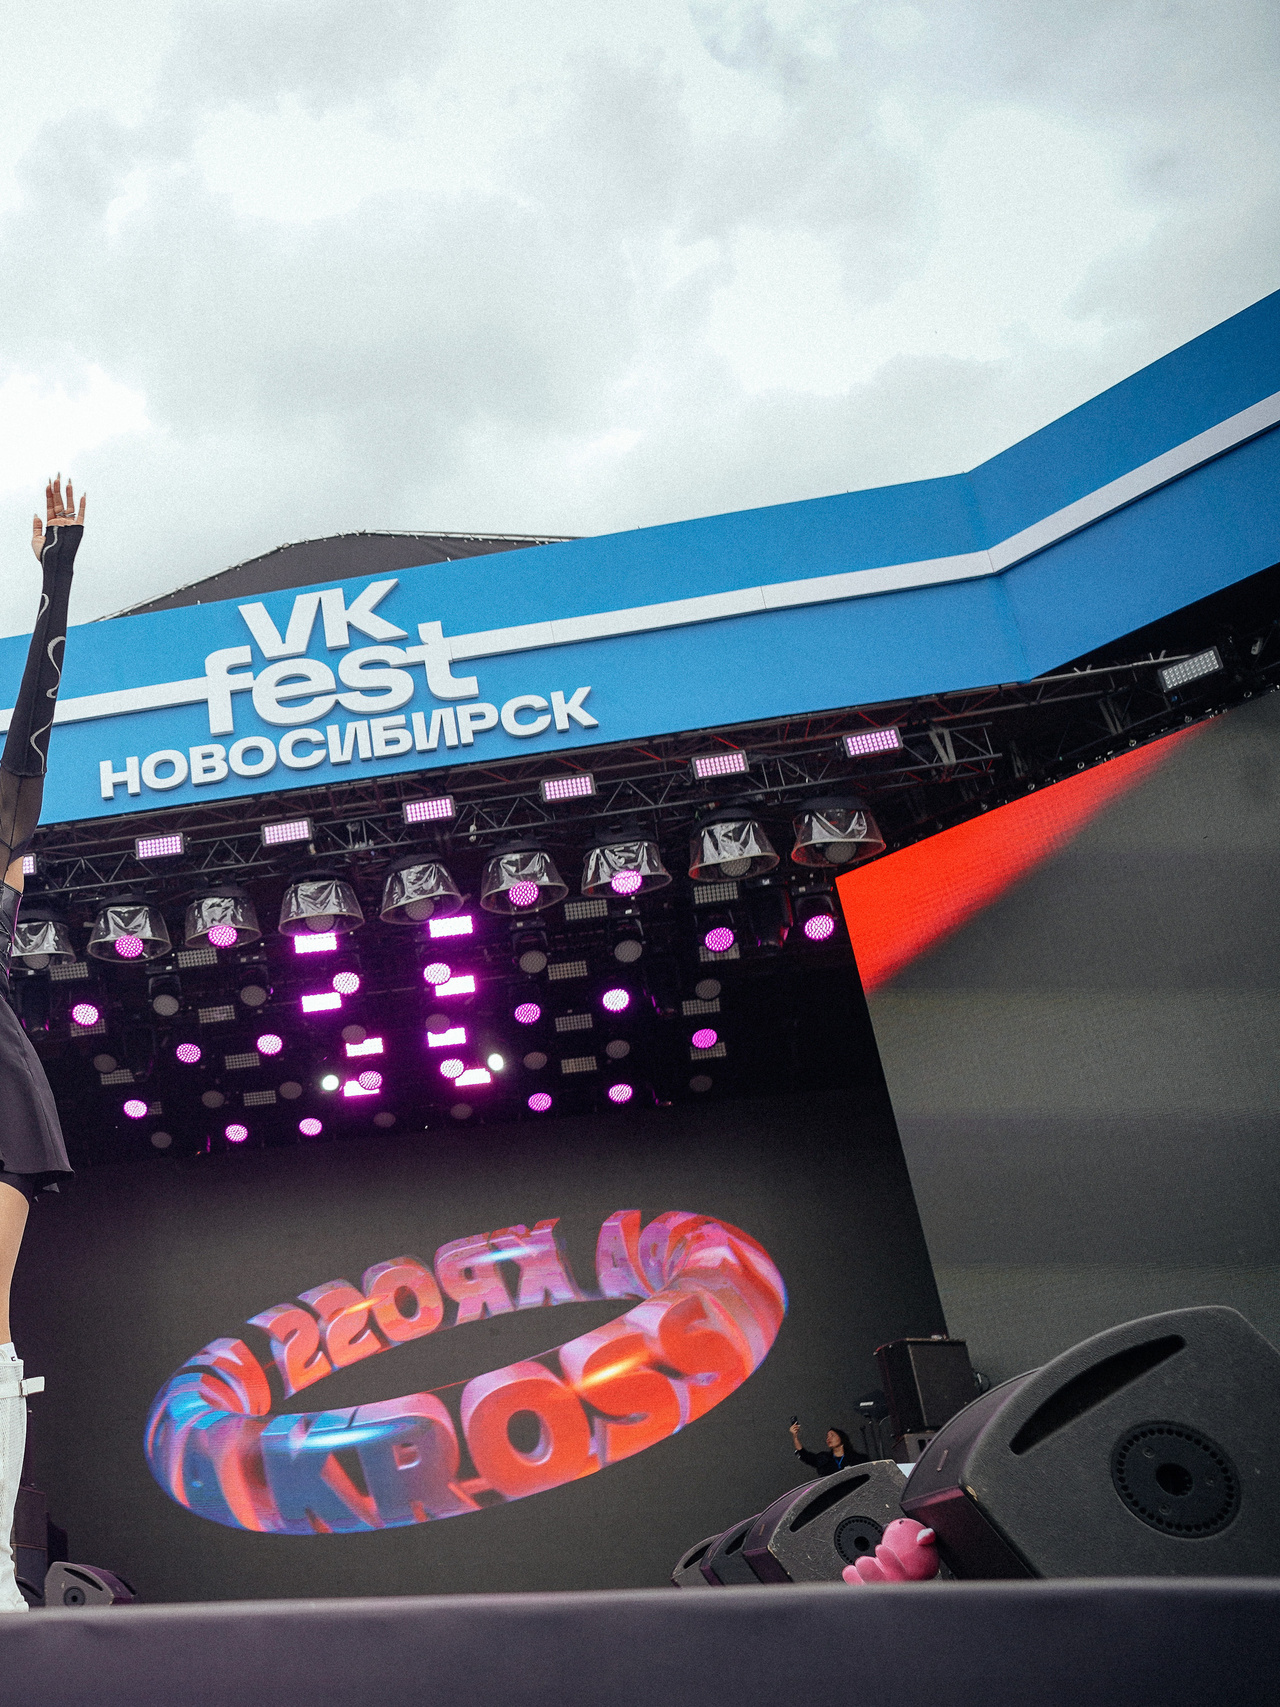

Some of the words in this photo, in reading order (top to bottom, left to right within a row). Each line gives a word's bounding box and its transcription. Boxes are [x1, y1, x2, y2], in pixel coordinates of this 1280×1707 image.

[238, 578, 408, 660] VK
[204, 620, 480, 736] fest
[99, 686, 599, 800] НОВОСИБИРСК
